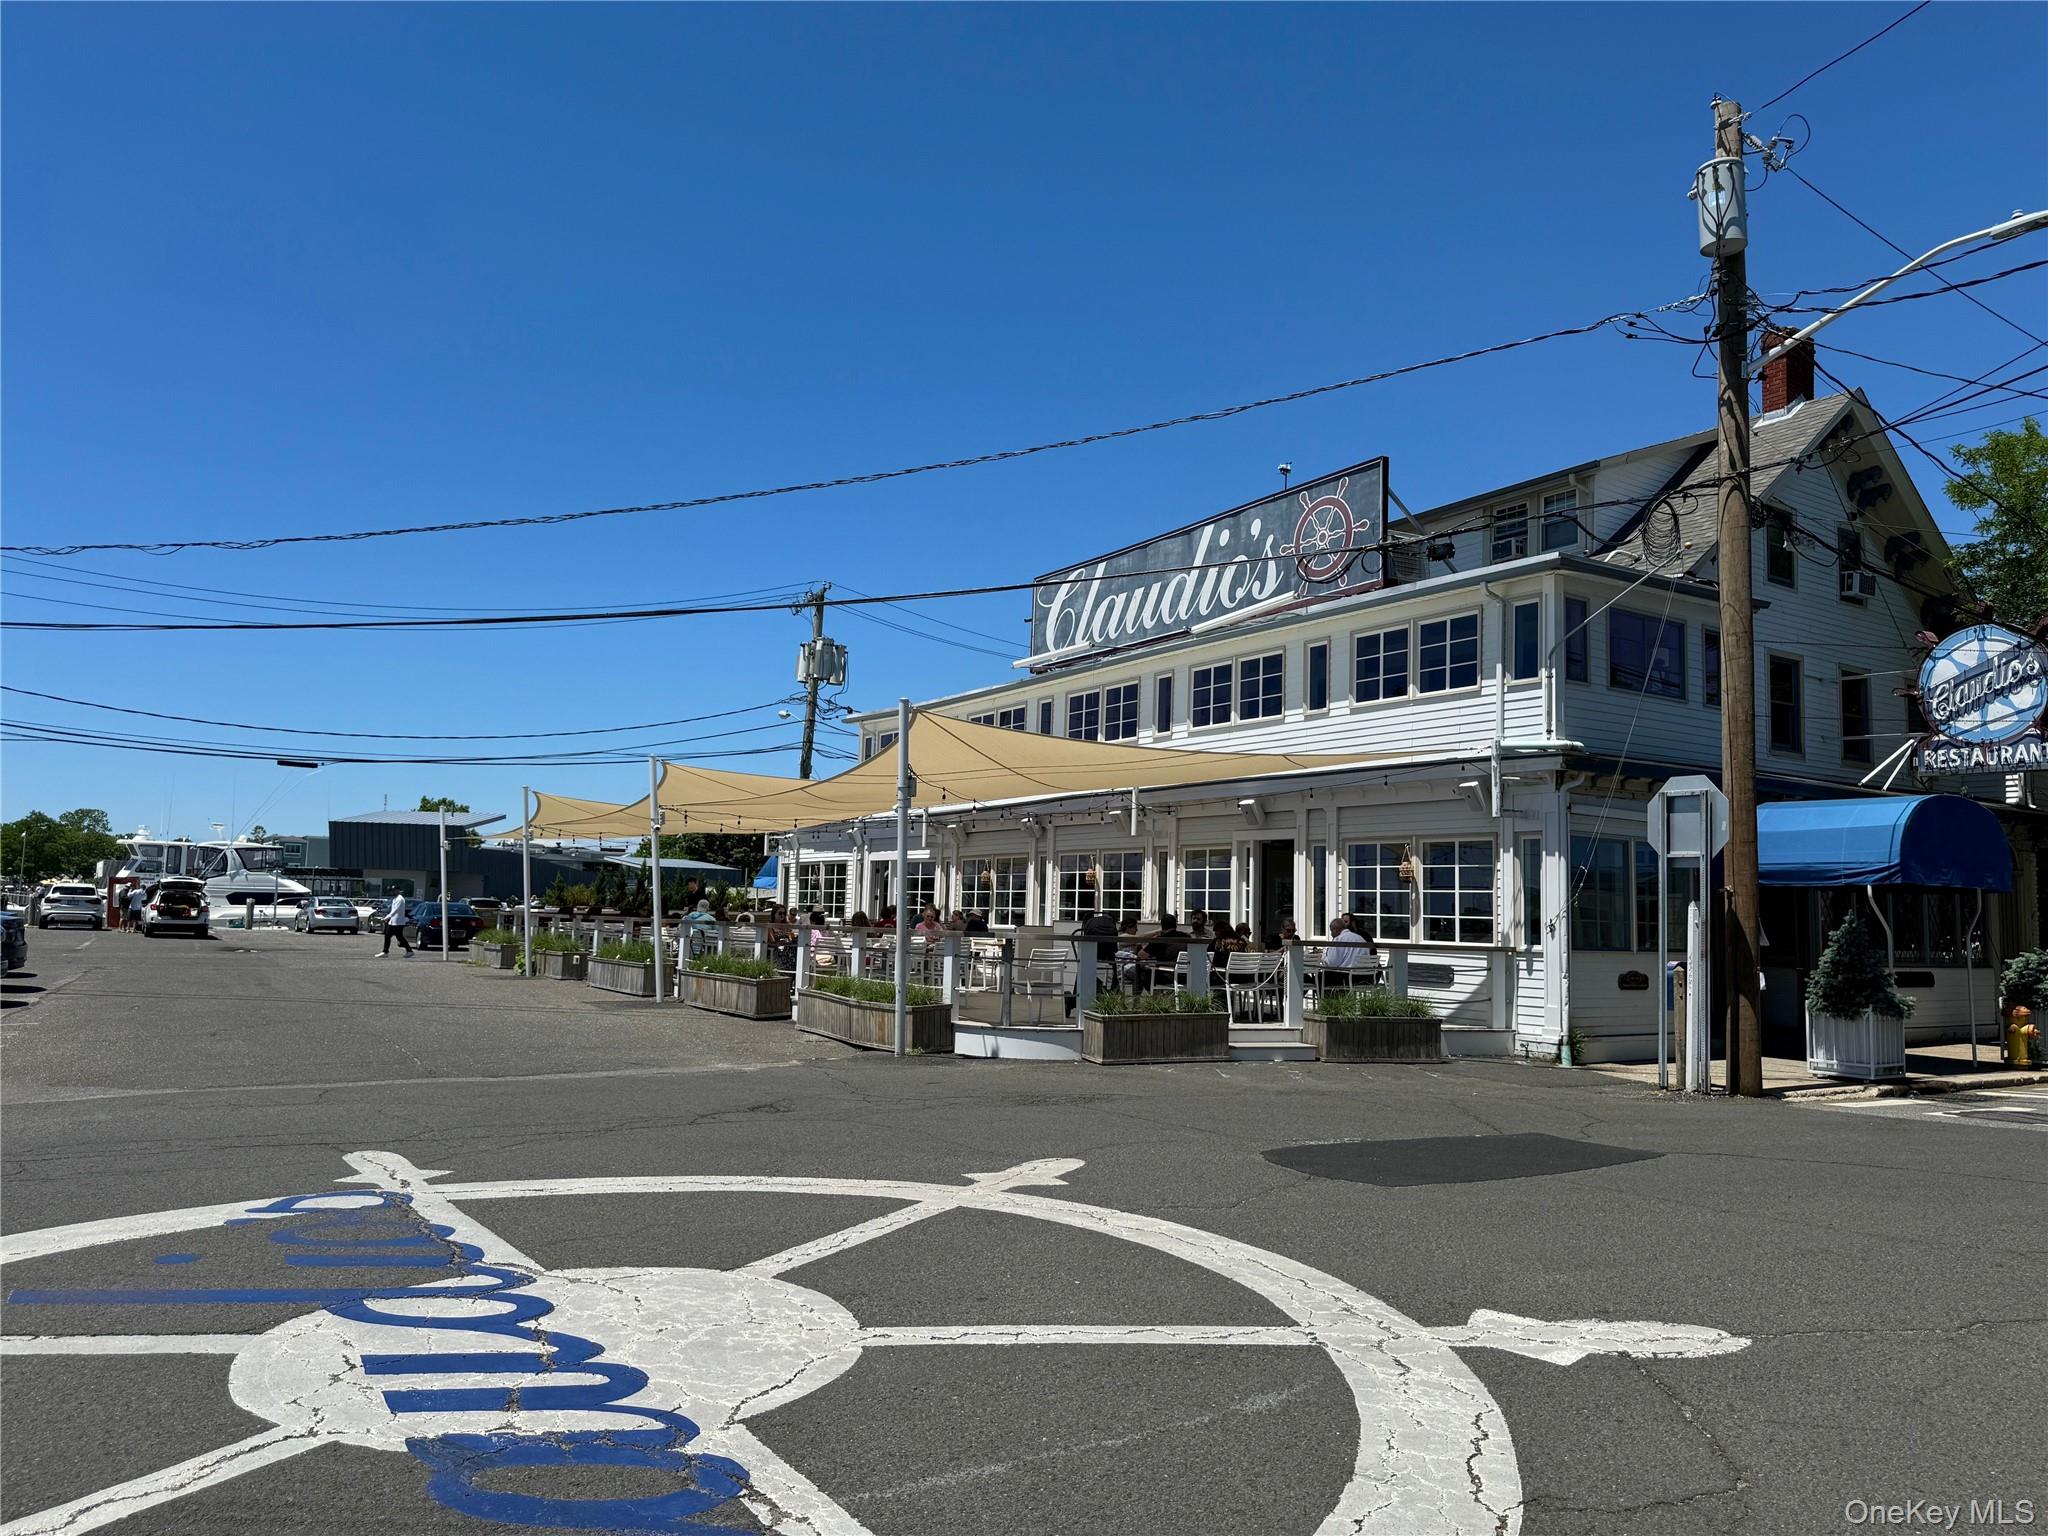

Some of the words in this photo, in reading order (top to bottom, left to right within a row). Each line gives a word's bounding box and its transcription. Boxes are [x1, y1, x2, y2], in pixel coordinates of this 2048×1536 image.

[1036, 518, 1284, 660] Claudio's
[1931, 648, 2040, 721] Claudio's
[8, 1188, 766, 1536] audio's
